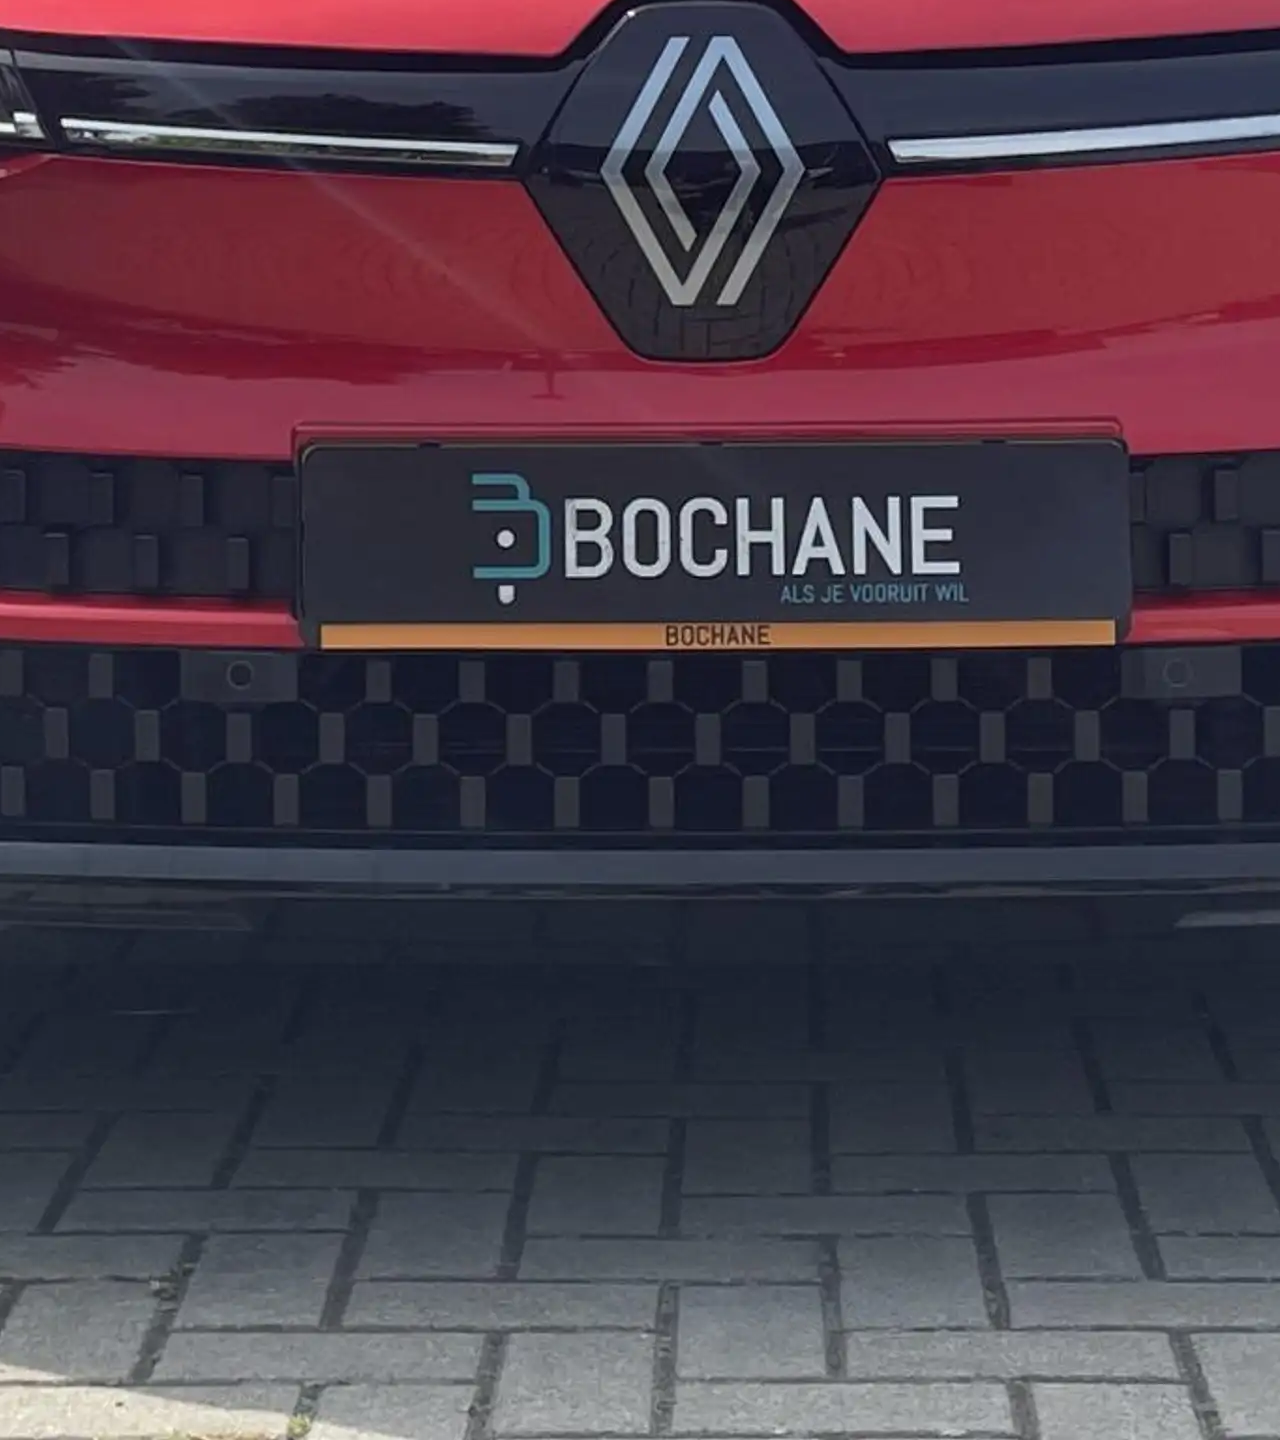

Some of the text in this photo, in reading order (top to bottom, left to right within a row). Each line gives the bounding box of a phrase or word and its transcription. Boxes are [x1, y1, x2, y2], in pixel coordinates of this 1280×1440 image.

[564, 495, 961, 579] BOCHANE
[780, 582, 970, 604] ALS JE VOORUIT WIL
[665, 624, 772, 646] BOCHANE
